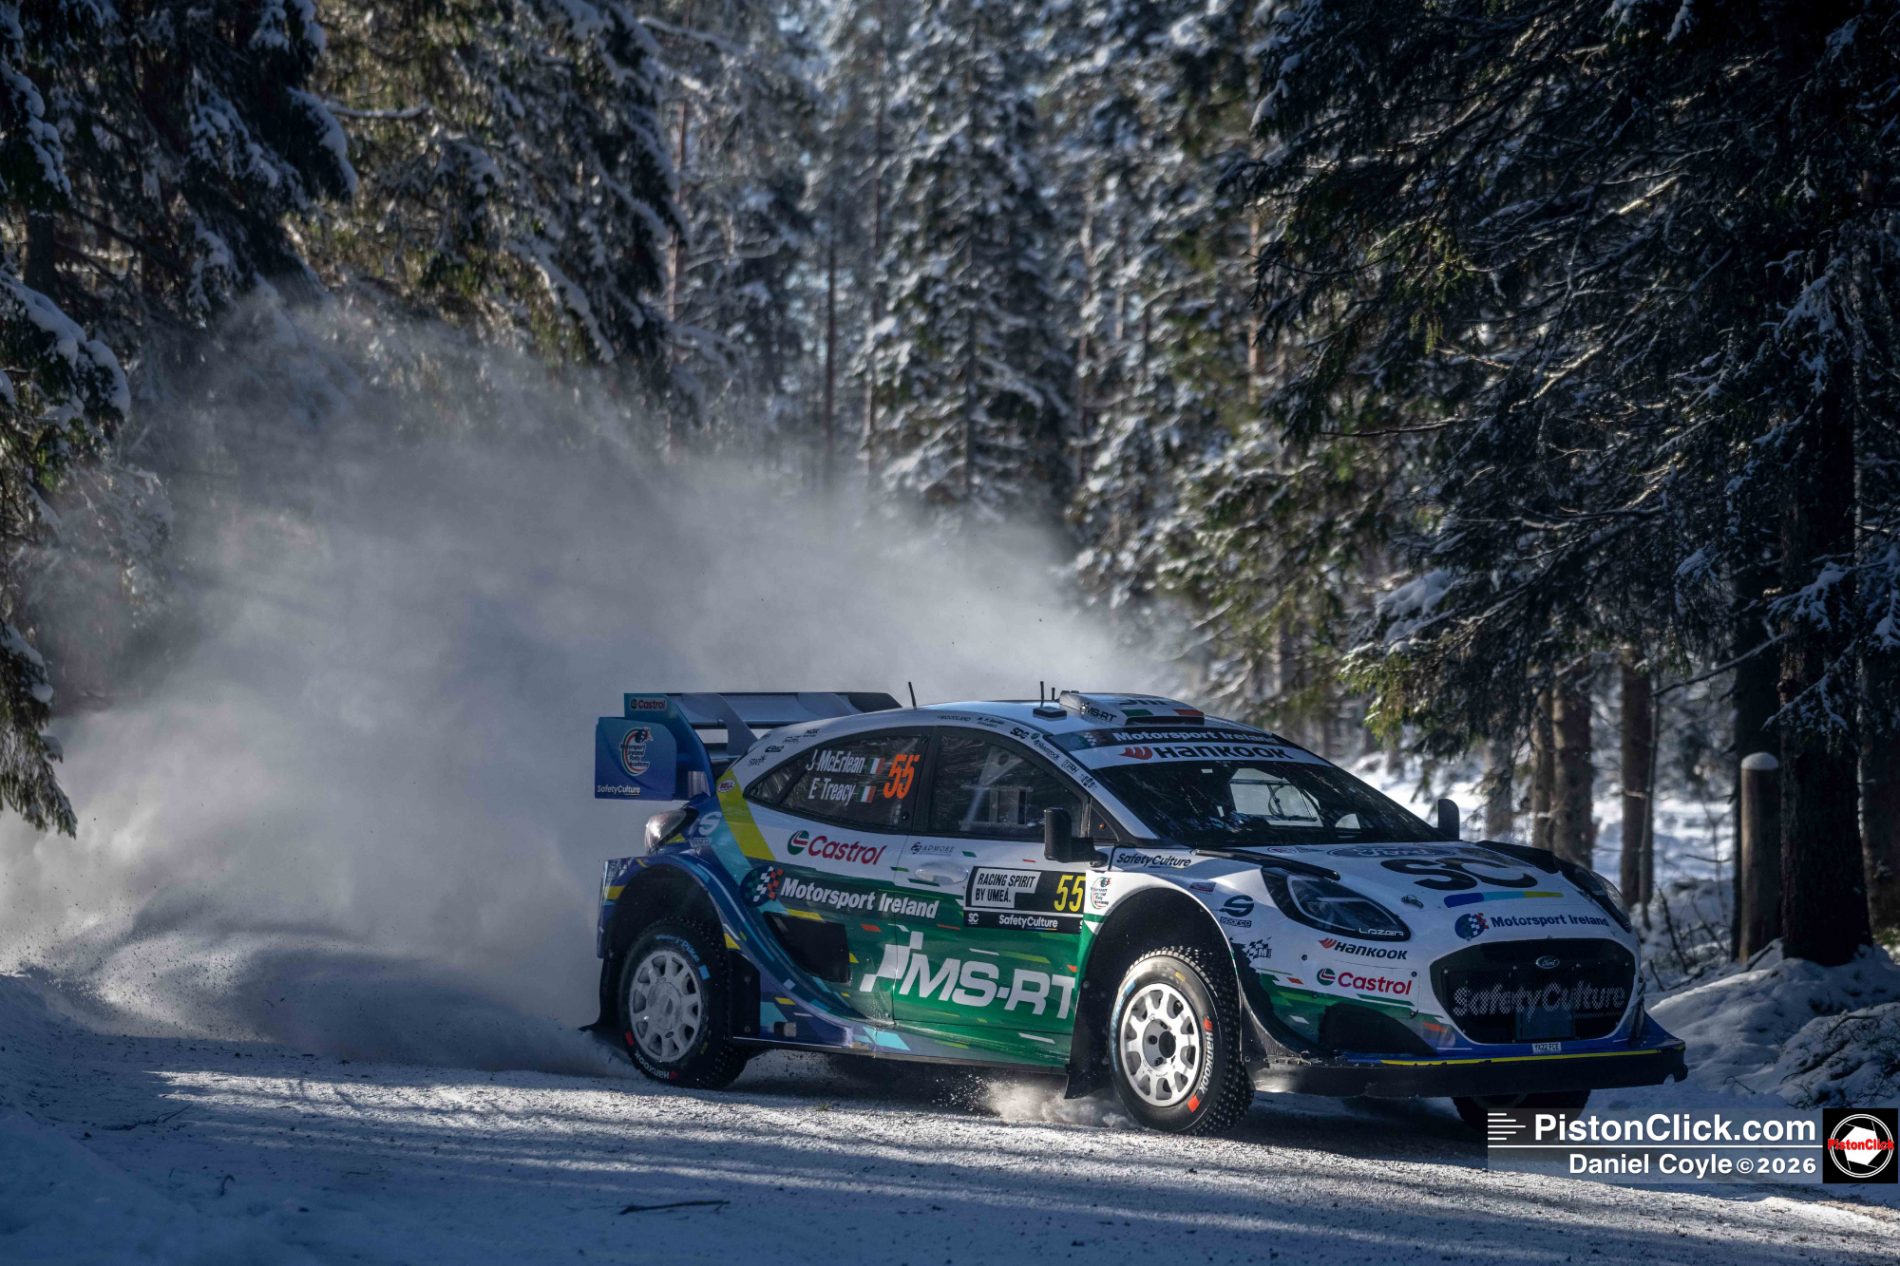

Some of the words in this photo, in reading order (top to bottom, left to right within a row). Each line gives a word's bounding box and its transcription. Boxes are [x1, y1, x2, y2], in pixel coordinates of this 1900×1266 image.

[638, 700, 666, 709] Castrol
[1112, 731, 1217, 743] Motorsport
[1218, 730, 1279, 744] Ireland
[1152, 745, 1294, 760] Hankook
[806, 749, 818, 771] J
[817, 750, 865, 774] McErlean
[883, 754, 920, 800] 55
[597, 785, 641, 795] SafetyCulture
[807, 777, 819, 799] E
[820, 778, 857, 806] Treacy
[808, 835, 887, 866] Castrol
[1117, 853, 1191, 868] SafetyCulture
[977, 873, 1007, 887] RACING
[1009, 875, 1036, 888] SPIRIT
[779, 877, 876, 910] Motorsport
[878, 892, 940, 919] Ireland
[975, 887, 986, 901] BY
[1054, 874, 1086, 912] 55
[968, 912, 979, 923] SC
[999, 914, 1058, 928] SafetyCulture
[1490, 914, 1565, 928] Motorsport
[1569, 914, 1610, 927] Ireland
[1334, 941, 1408, 960] Hankook
[899, 953, 1076, 1019] MS-RT
[1338, 972, 1412, 995] Castrol
[1453, 979, 1626, 1022] SafetyCulture
